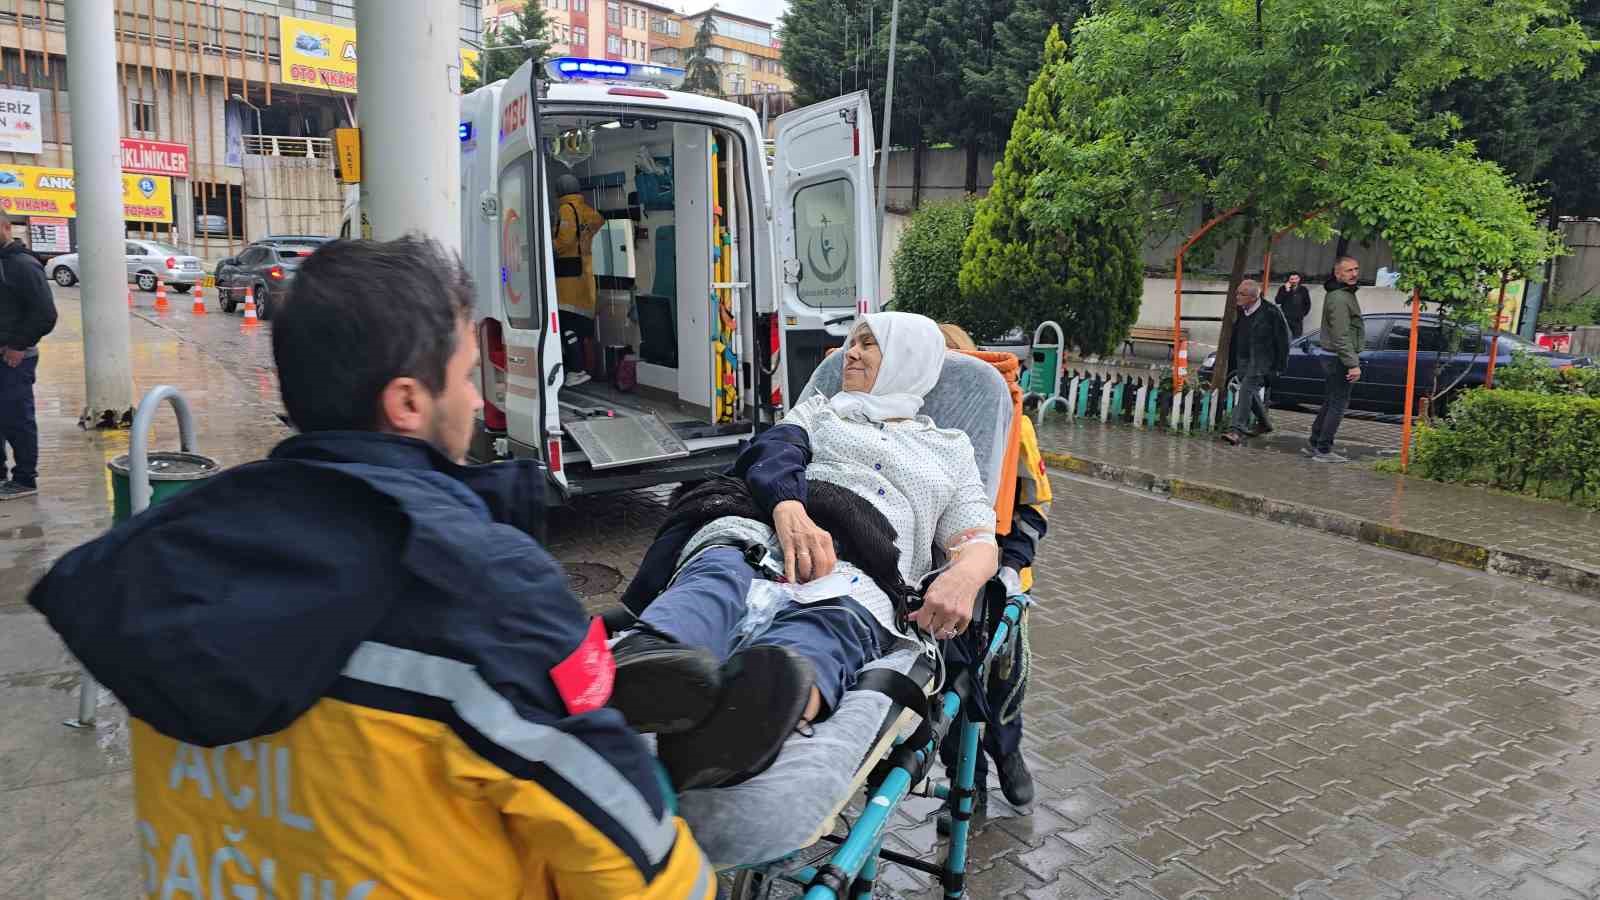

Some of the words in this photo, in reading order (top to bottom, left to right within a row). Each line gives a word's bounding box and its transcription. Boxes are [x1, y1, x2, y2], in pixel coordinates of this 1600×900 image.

[291, 64, 316, 82] OTO
[501, 91, 529, 137] MBU
[15, 197, 58, 212] YIKAMA
